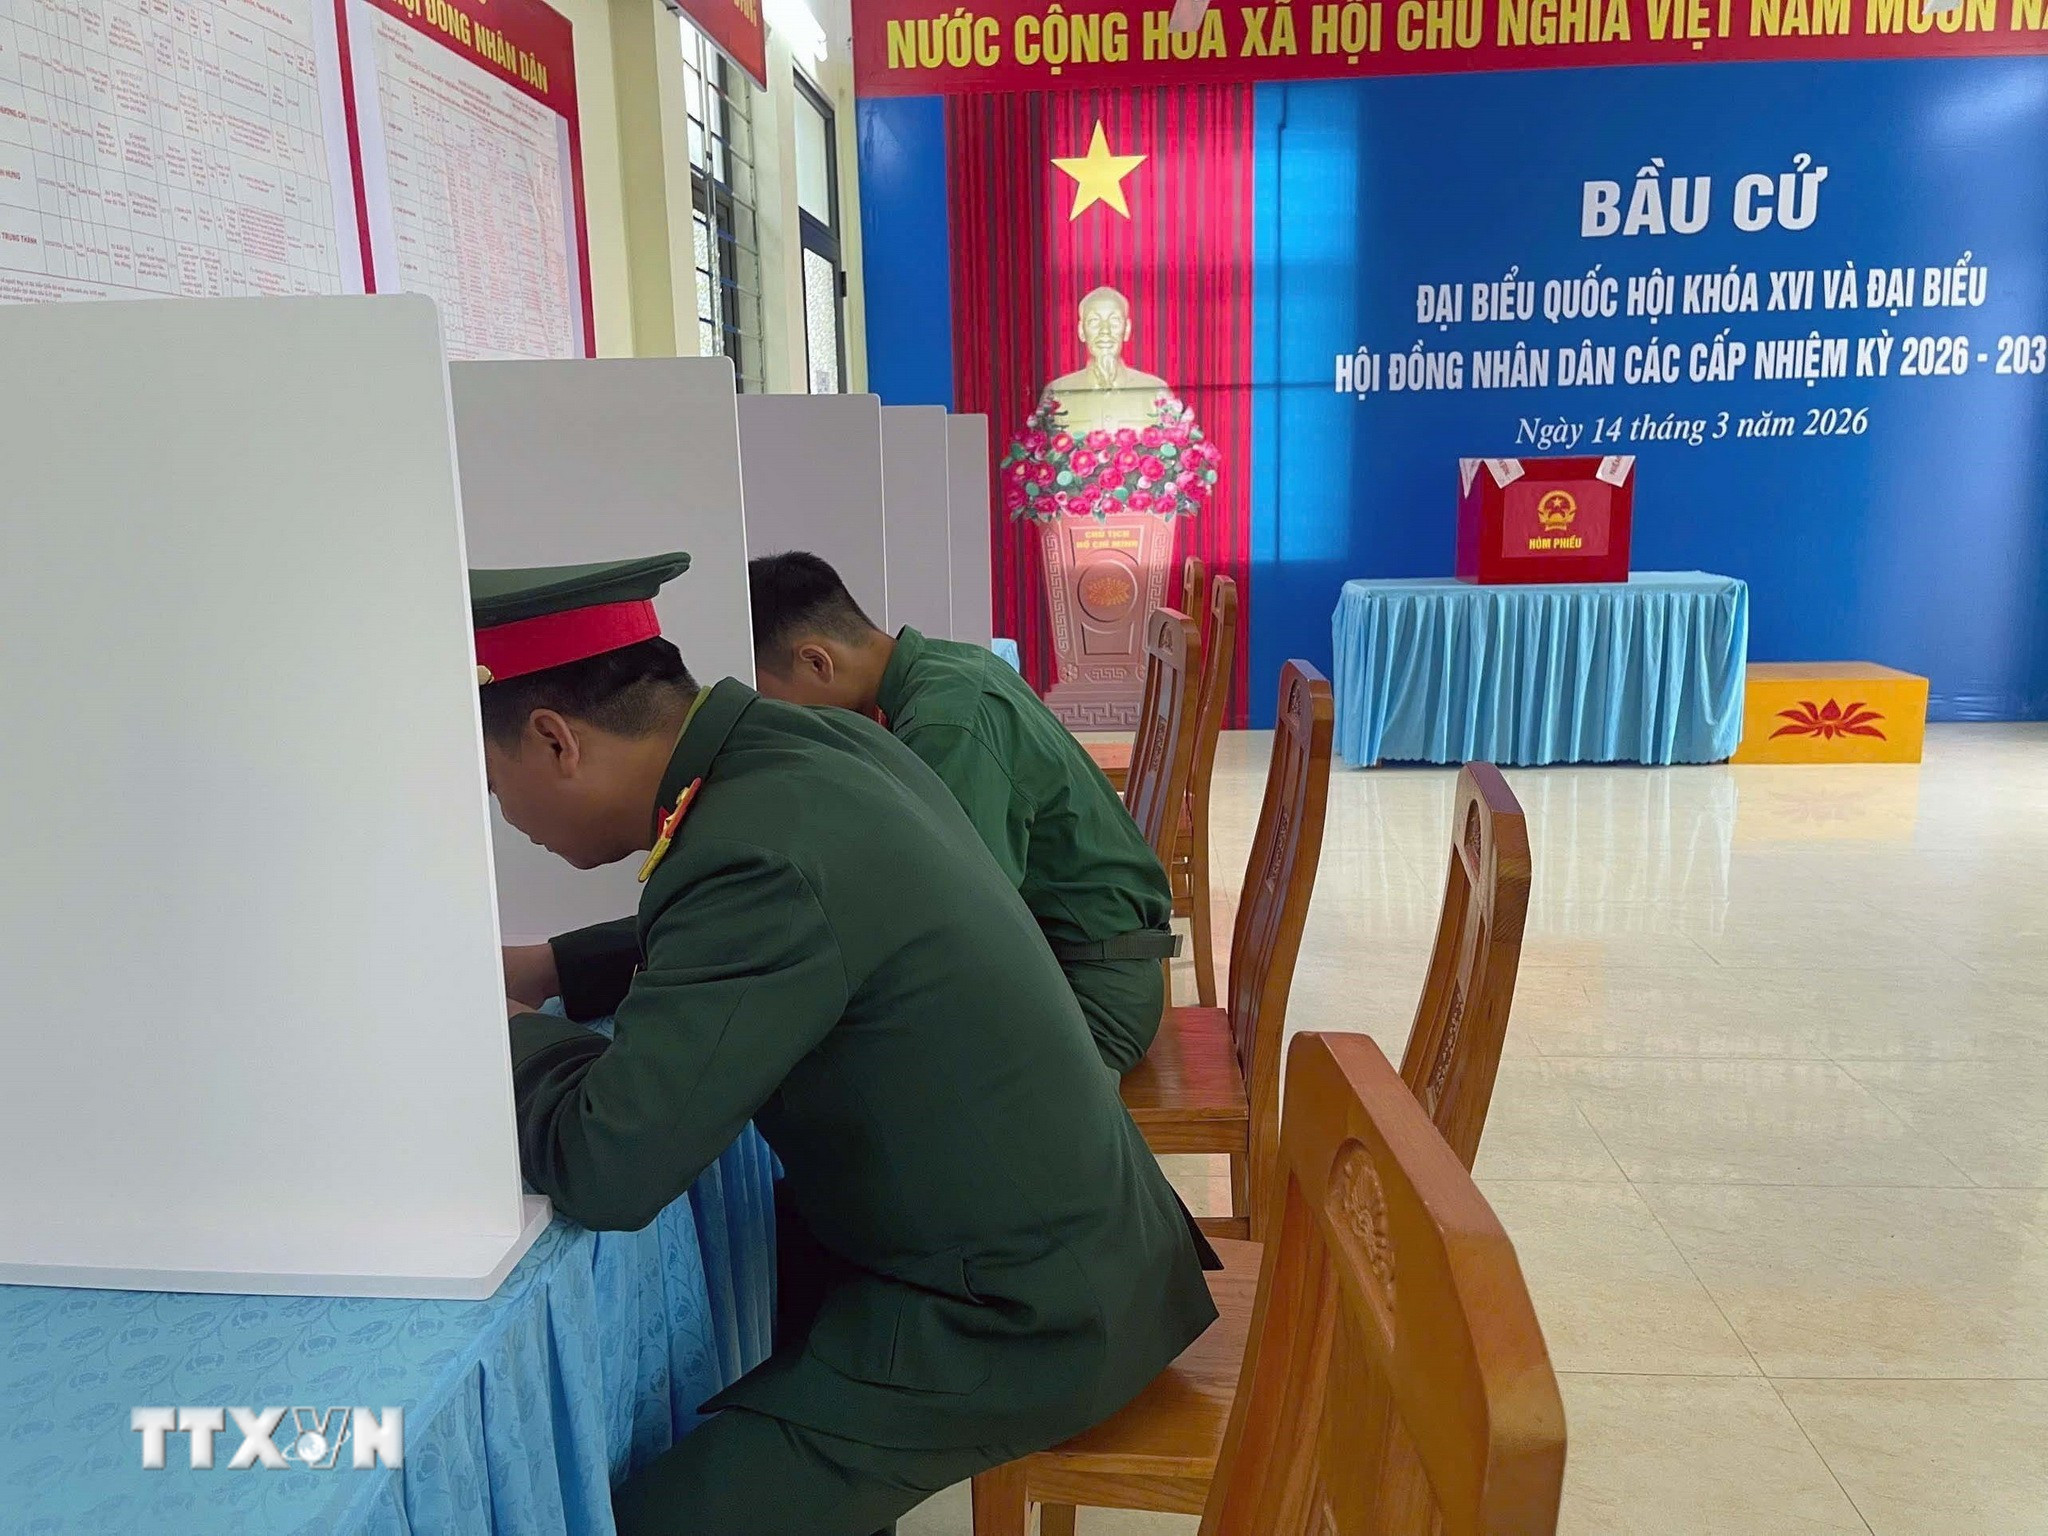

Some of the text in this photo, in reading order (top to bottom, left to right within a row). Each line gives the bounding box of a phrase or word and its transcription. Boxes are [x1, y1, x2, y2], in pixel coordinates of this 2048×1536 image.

[474, 20, 517, 74] NHÂN
[520, 51, 548, 94] DÂN
[887, 7, 1000, 69] NƯỚC
[1014, 3, 1129, 75] CỘNG
[1749, 0, 1850, 37] NAM
[1581, 153, 1828, 237] BẦU CỬ
[1417, 250, 1988, 331] ĐẠI BIỂU QUỐC HỘI KHÓA XVI VÀ ĐẠI BIỂU
[1335, 346, 1380, 400] HỘI
[1388, 339, 1463, 391] ĐỒNG
[1472, 341, 1549, 389] NHÂN
[1557, 339, 1616, 387] DÂN
[1624, 336, 1681, 385] CÁC
[1689, 328, 1747, 382] CẤP
[1754, 330, 1849, 387] NHIỆM
[1856, 329, 1894, 377] KỲ
[1900, 335, 1969, 376] 2026
[1515, 407, 1869, 450] Ngày 14 tháng 3 năm 2026
[1529, 534, 1582, 550] HÒM PHIẾU
